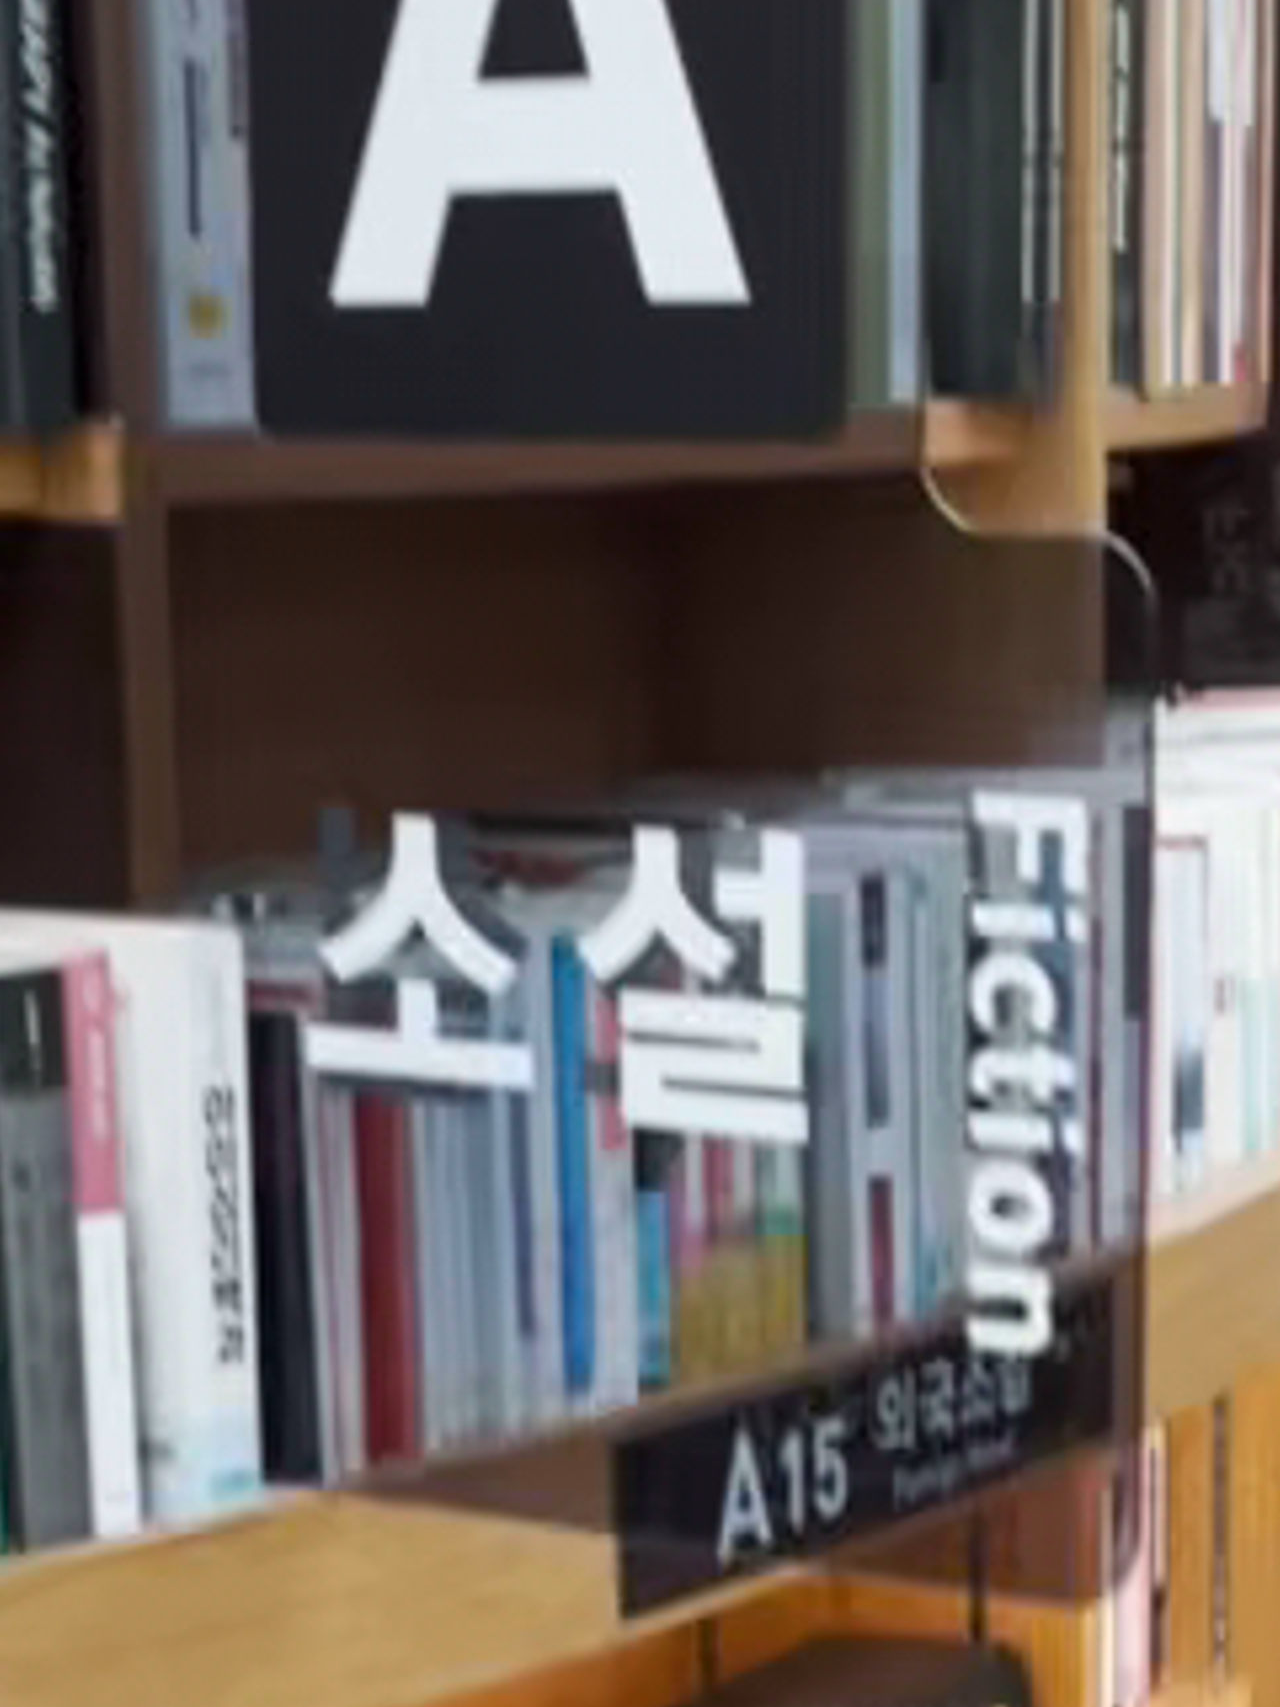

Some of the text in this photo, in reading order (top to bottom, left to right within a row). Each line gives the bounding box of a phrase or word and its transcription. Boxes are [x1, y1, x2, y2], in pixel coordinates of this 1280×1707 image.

[304, 812, 810, 1143] 소설
[966, 790, 1087, 1357] Fiction
[718, 1411, 850, 1569] A15
